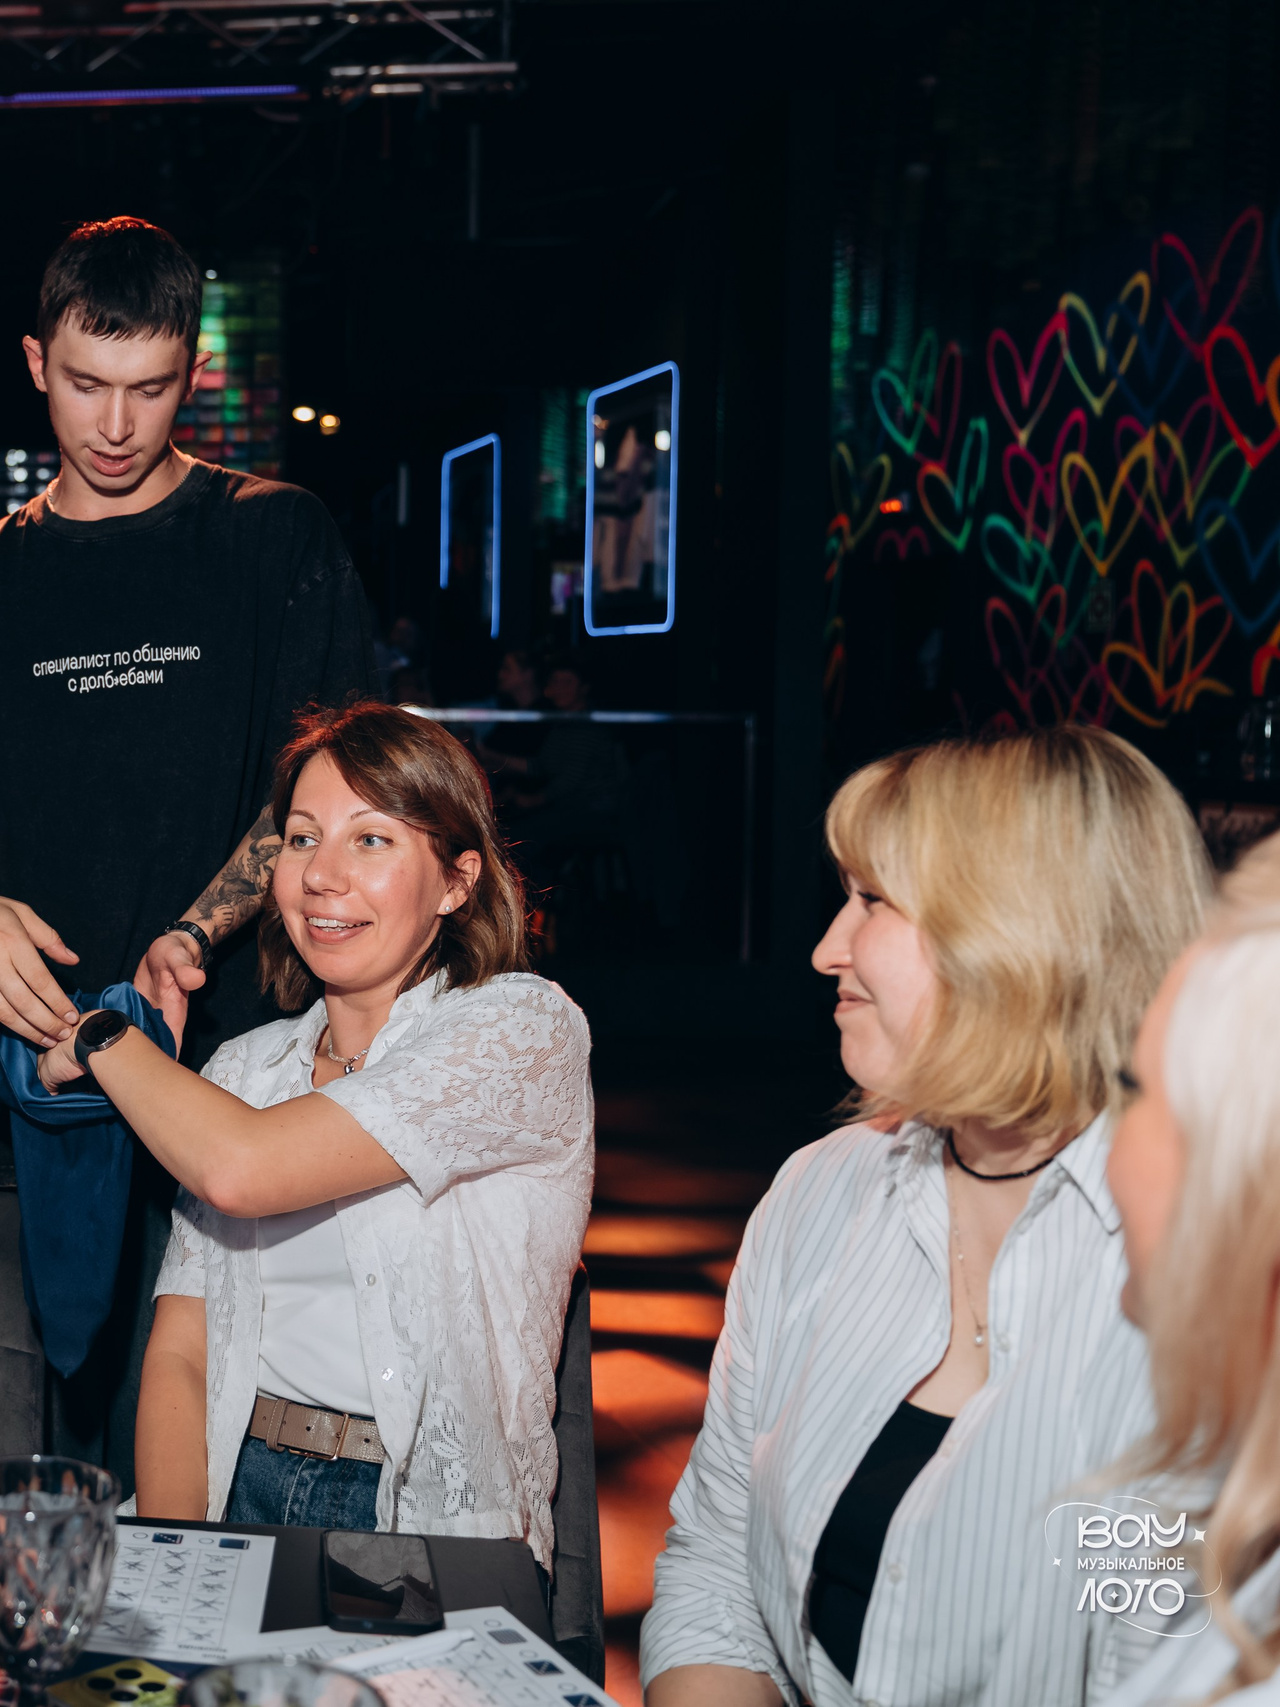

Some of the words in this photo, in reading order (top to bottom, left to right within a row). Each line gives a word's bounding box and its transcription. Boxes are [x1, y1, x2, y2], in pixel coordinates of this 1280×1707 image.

[32, 653, 111, 677] специалист
[113, 651, 131, 667] по
[132, 643, 200, 664] общению
[67, 677, 78, 692] с
